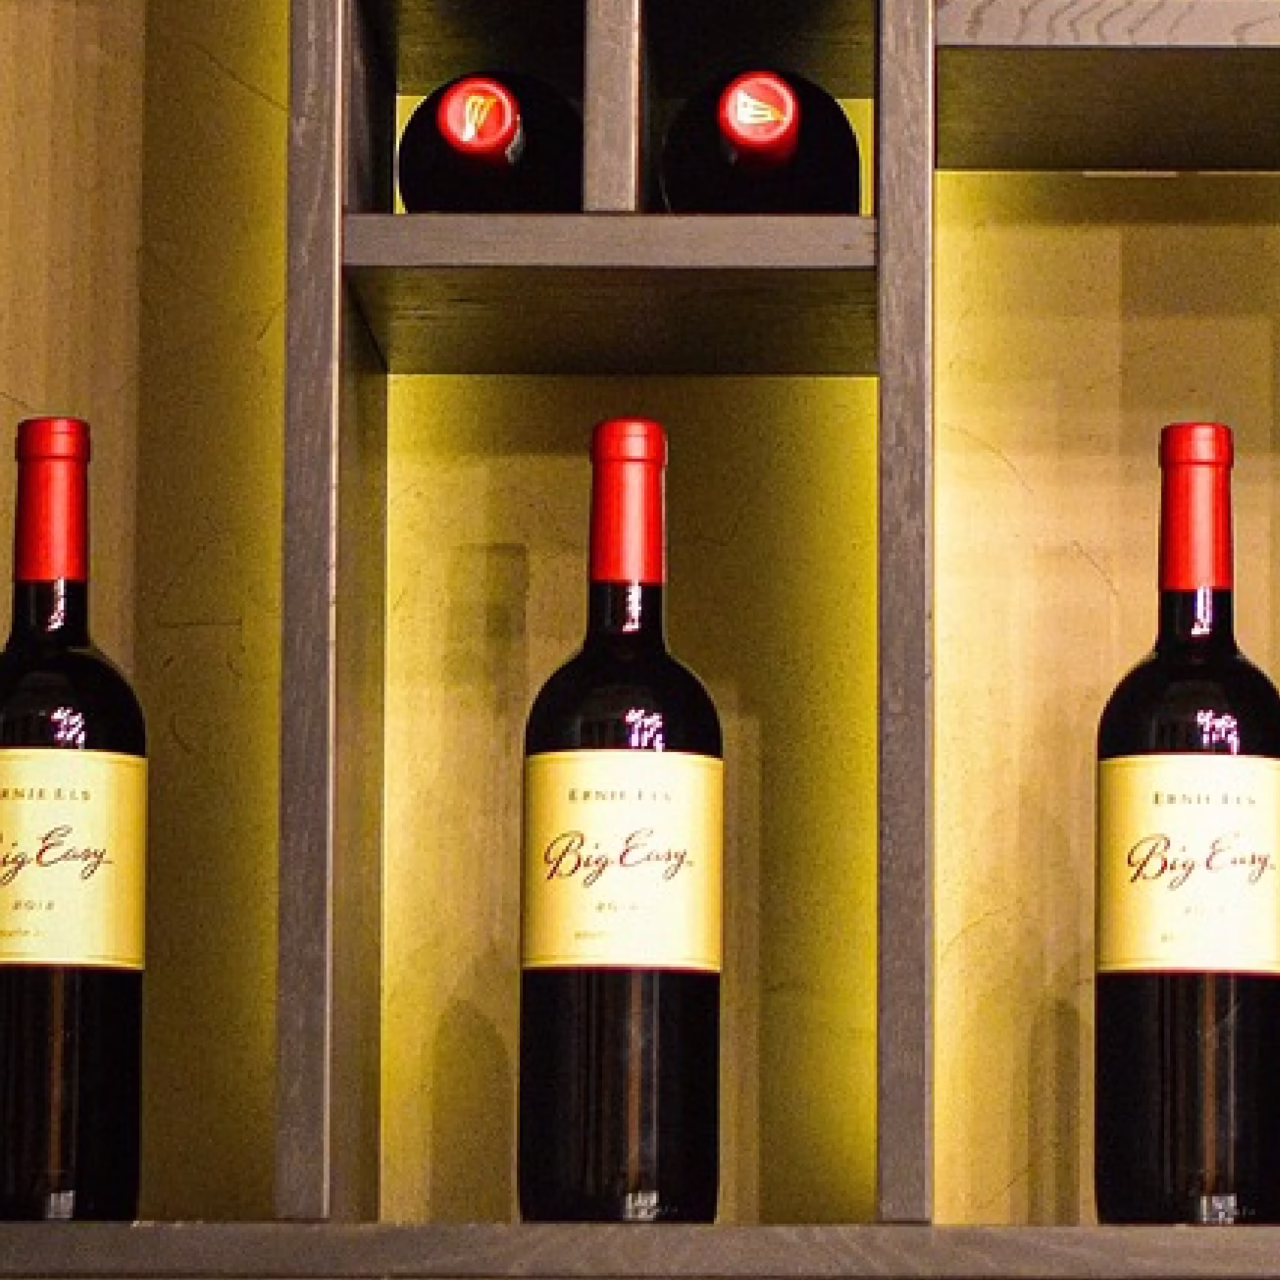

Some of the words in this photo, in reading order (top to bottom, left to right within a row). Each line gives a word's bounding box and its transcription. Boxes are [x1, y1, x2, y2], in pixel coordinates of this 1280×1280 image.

[36, 824, 114, 881] Easy
[544, 830, 609, 888] Big
[619, 828, 695, 881] Easy
[1127, 833, 1195, 891] Big
[1205, 831, 1277, 885] Easy
